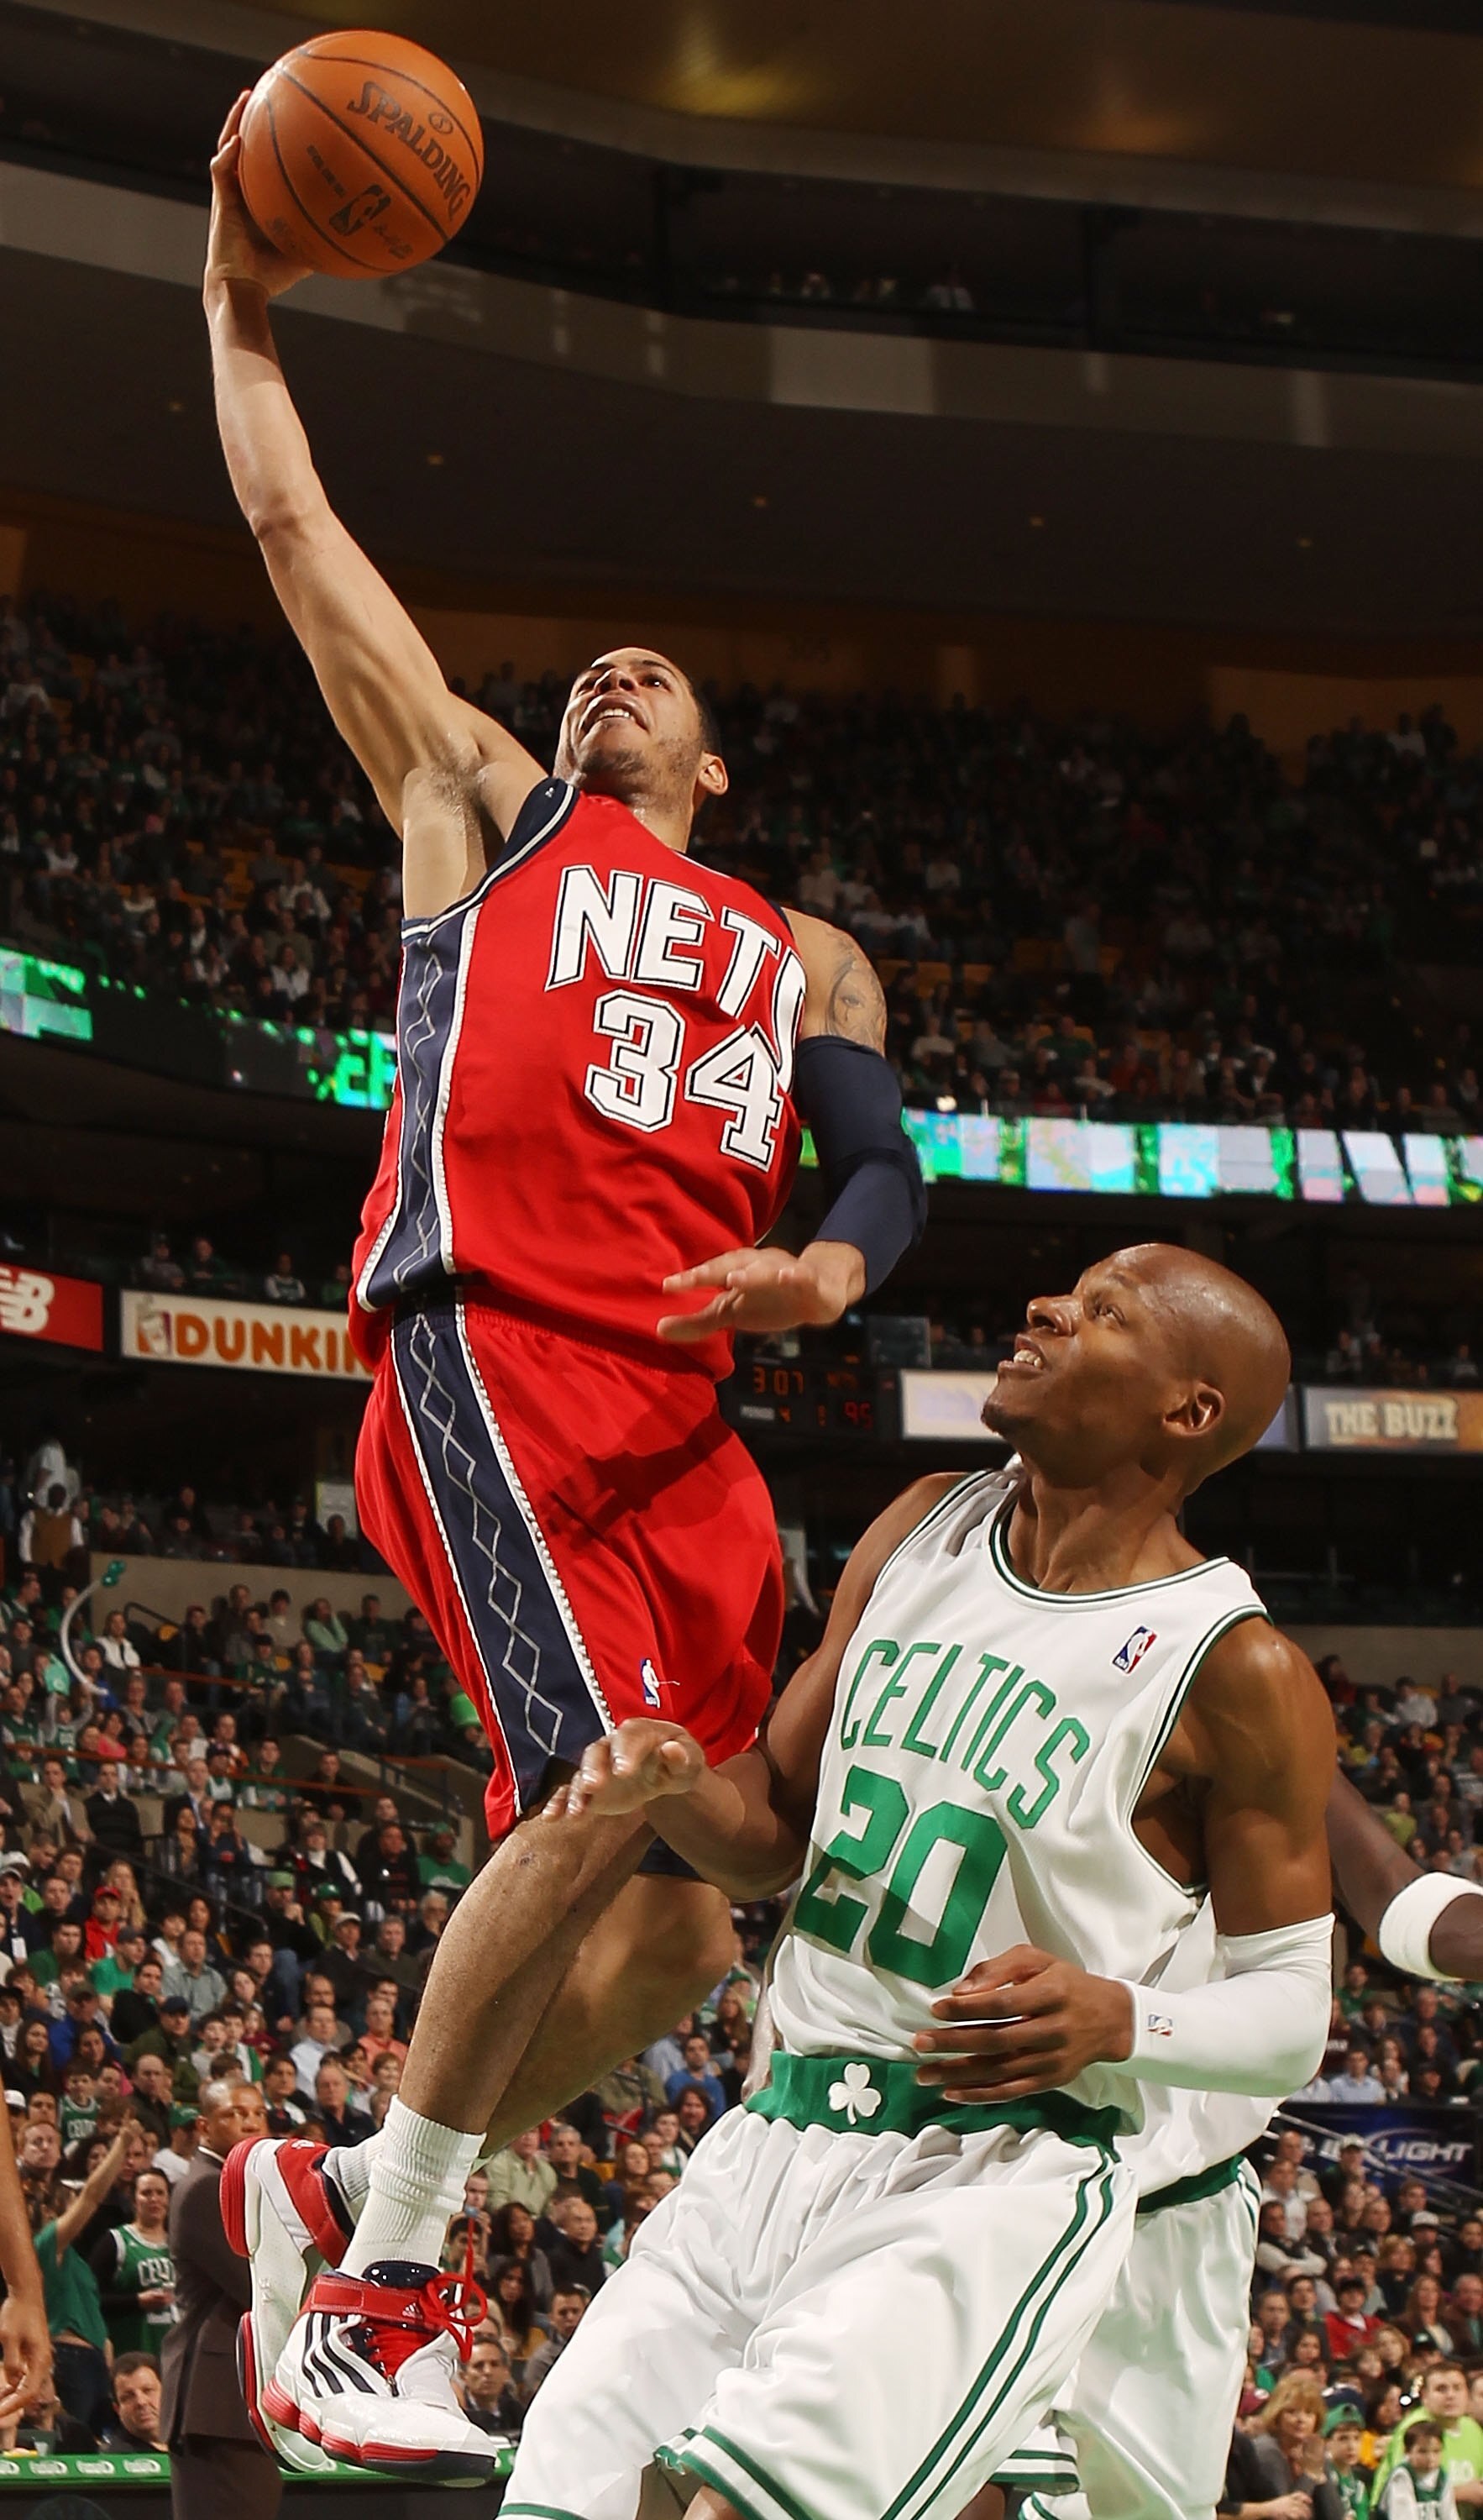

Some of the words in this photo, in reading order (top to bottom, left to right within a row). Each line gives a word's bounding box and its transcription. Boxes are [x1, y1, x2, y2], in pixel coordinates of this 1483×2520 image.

[347, 81, 471, 221] SPALDING
[584, 989, 785, 1173] 34
[1326, 1402, 1377, 1435] THE
[1384, 1400, 1458, 1439] BUZZ
[841, 1639, 1092, 1830] CELTICS
[794, 1765, 1008, 1989] 20
